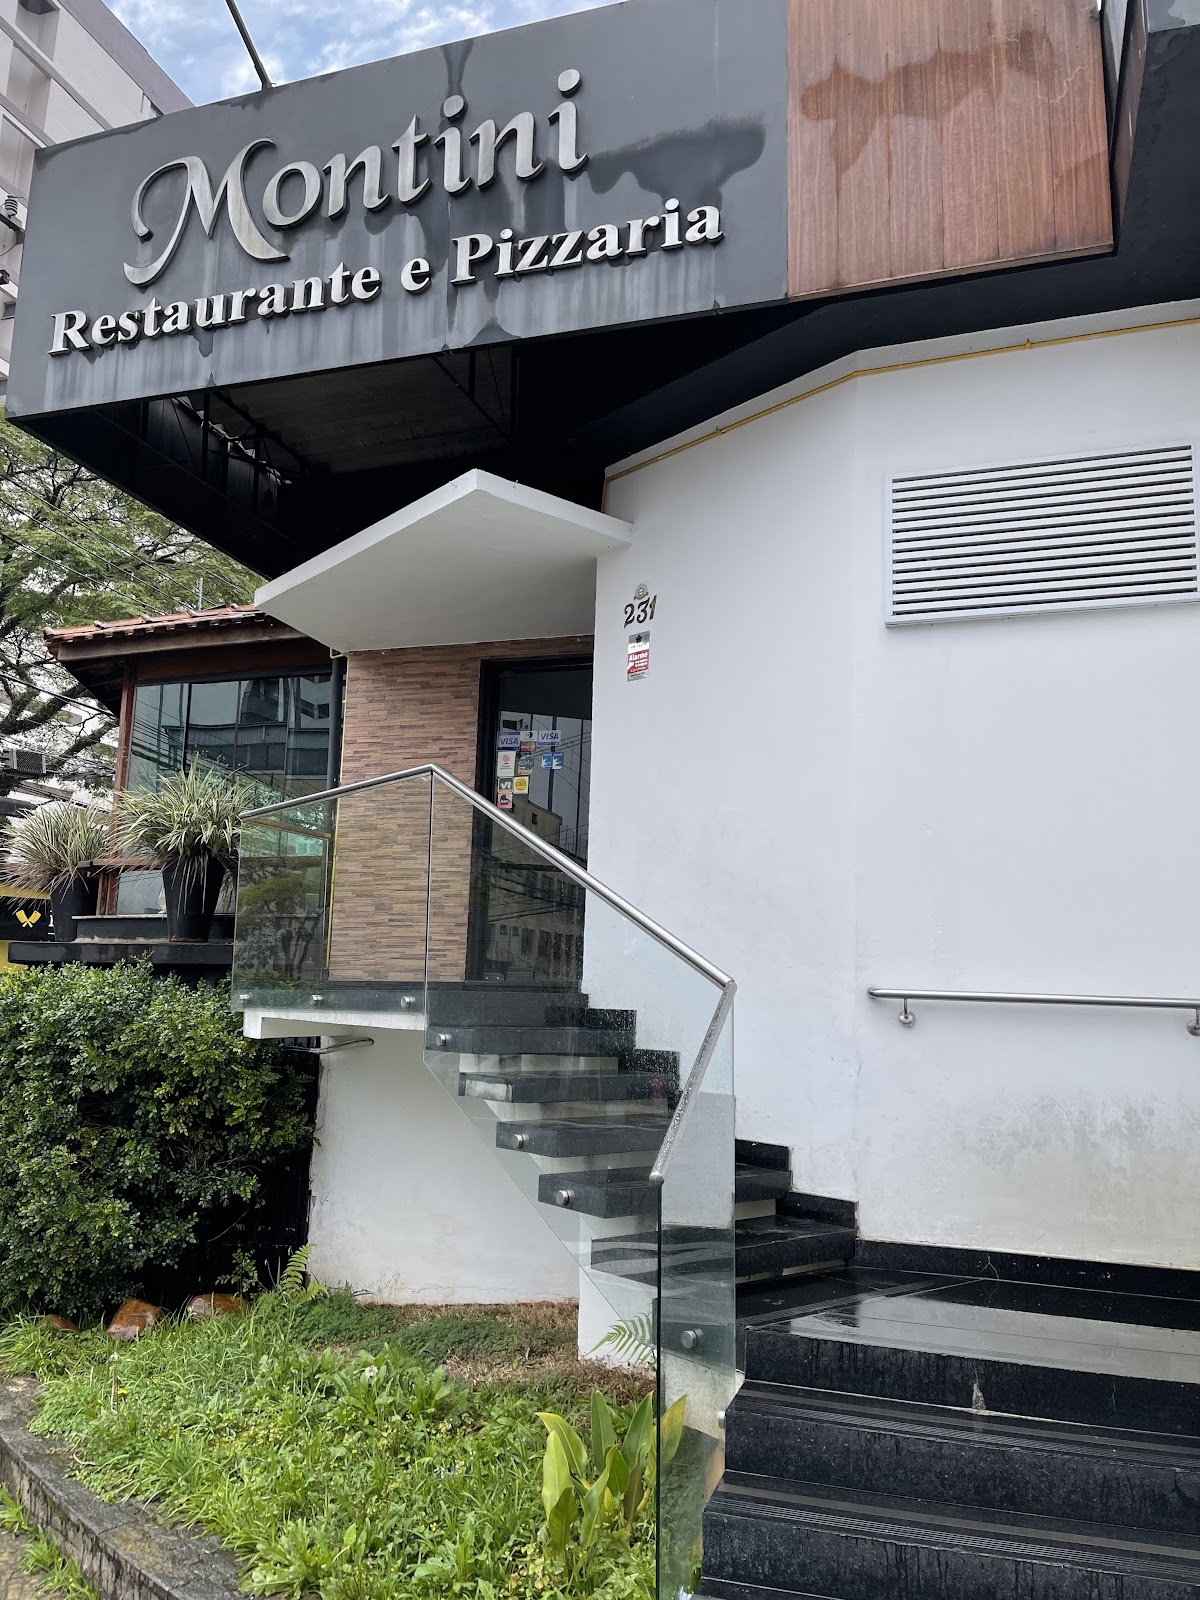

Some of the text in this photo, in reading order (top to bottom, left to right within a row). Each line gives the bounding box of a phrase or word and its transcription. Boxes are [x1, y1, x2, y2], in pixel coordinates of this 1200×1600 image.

[123, 68, 589, 286] Montini
[49, 197, 724, 355] Restaurante e Pizzaria
[623, 594, 657, 629] 231
[628, 652, 648, 661] Alarme
